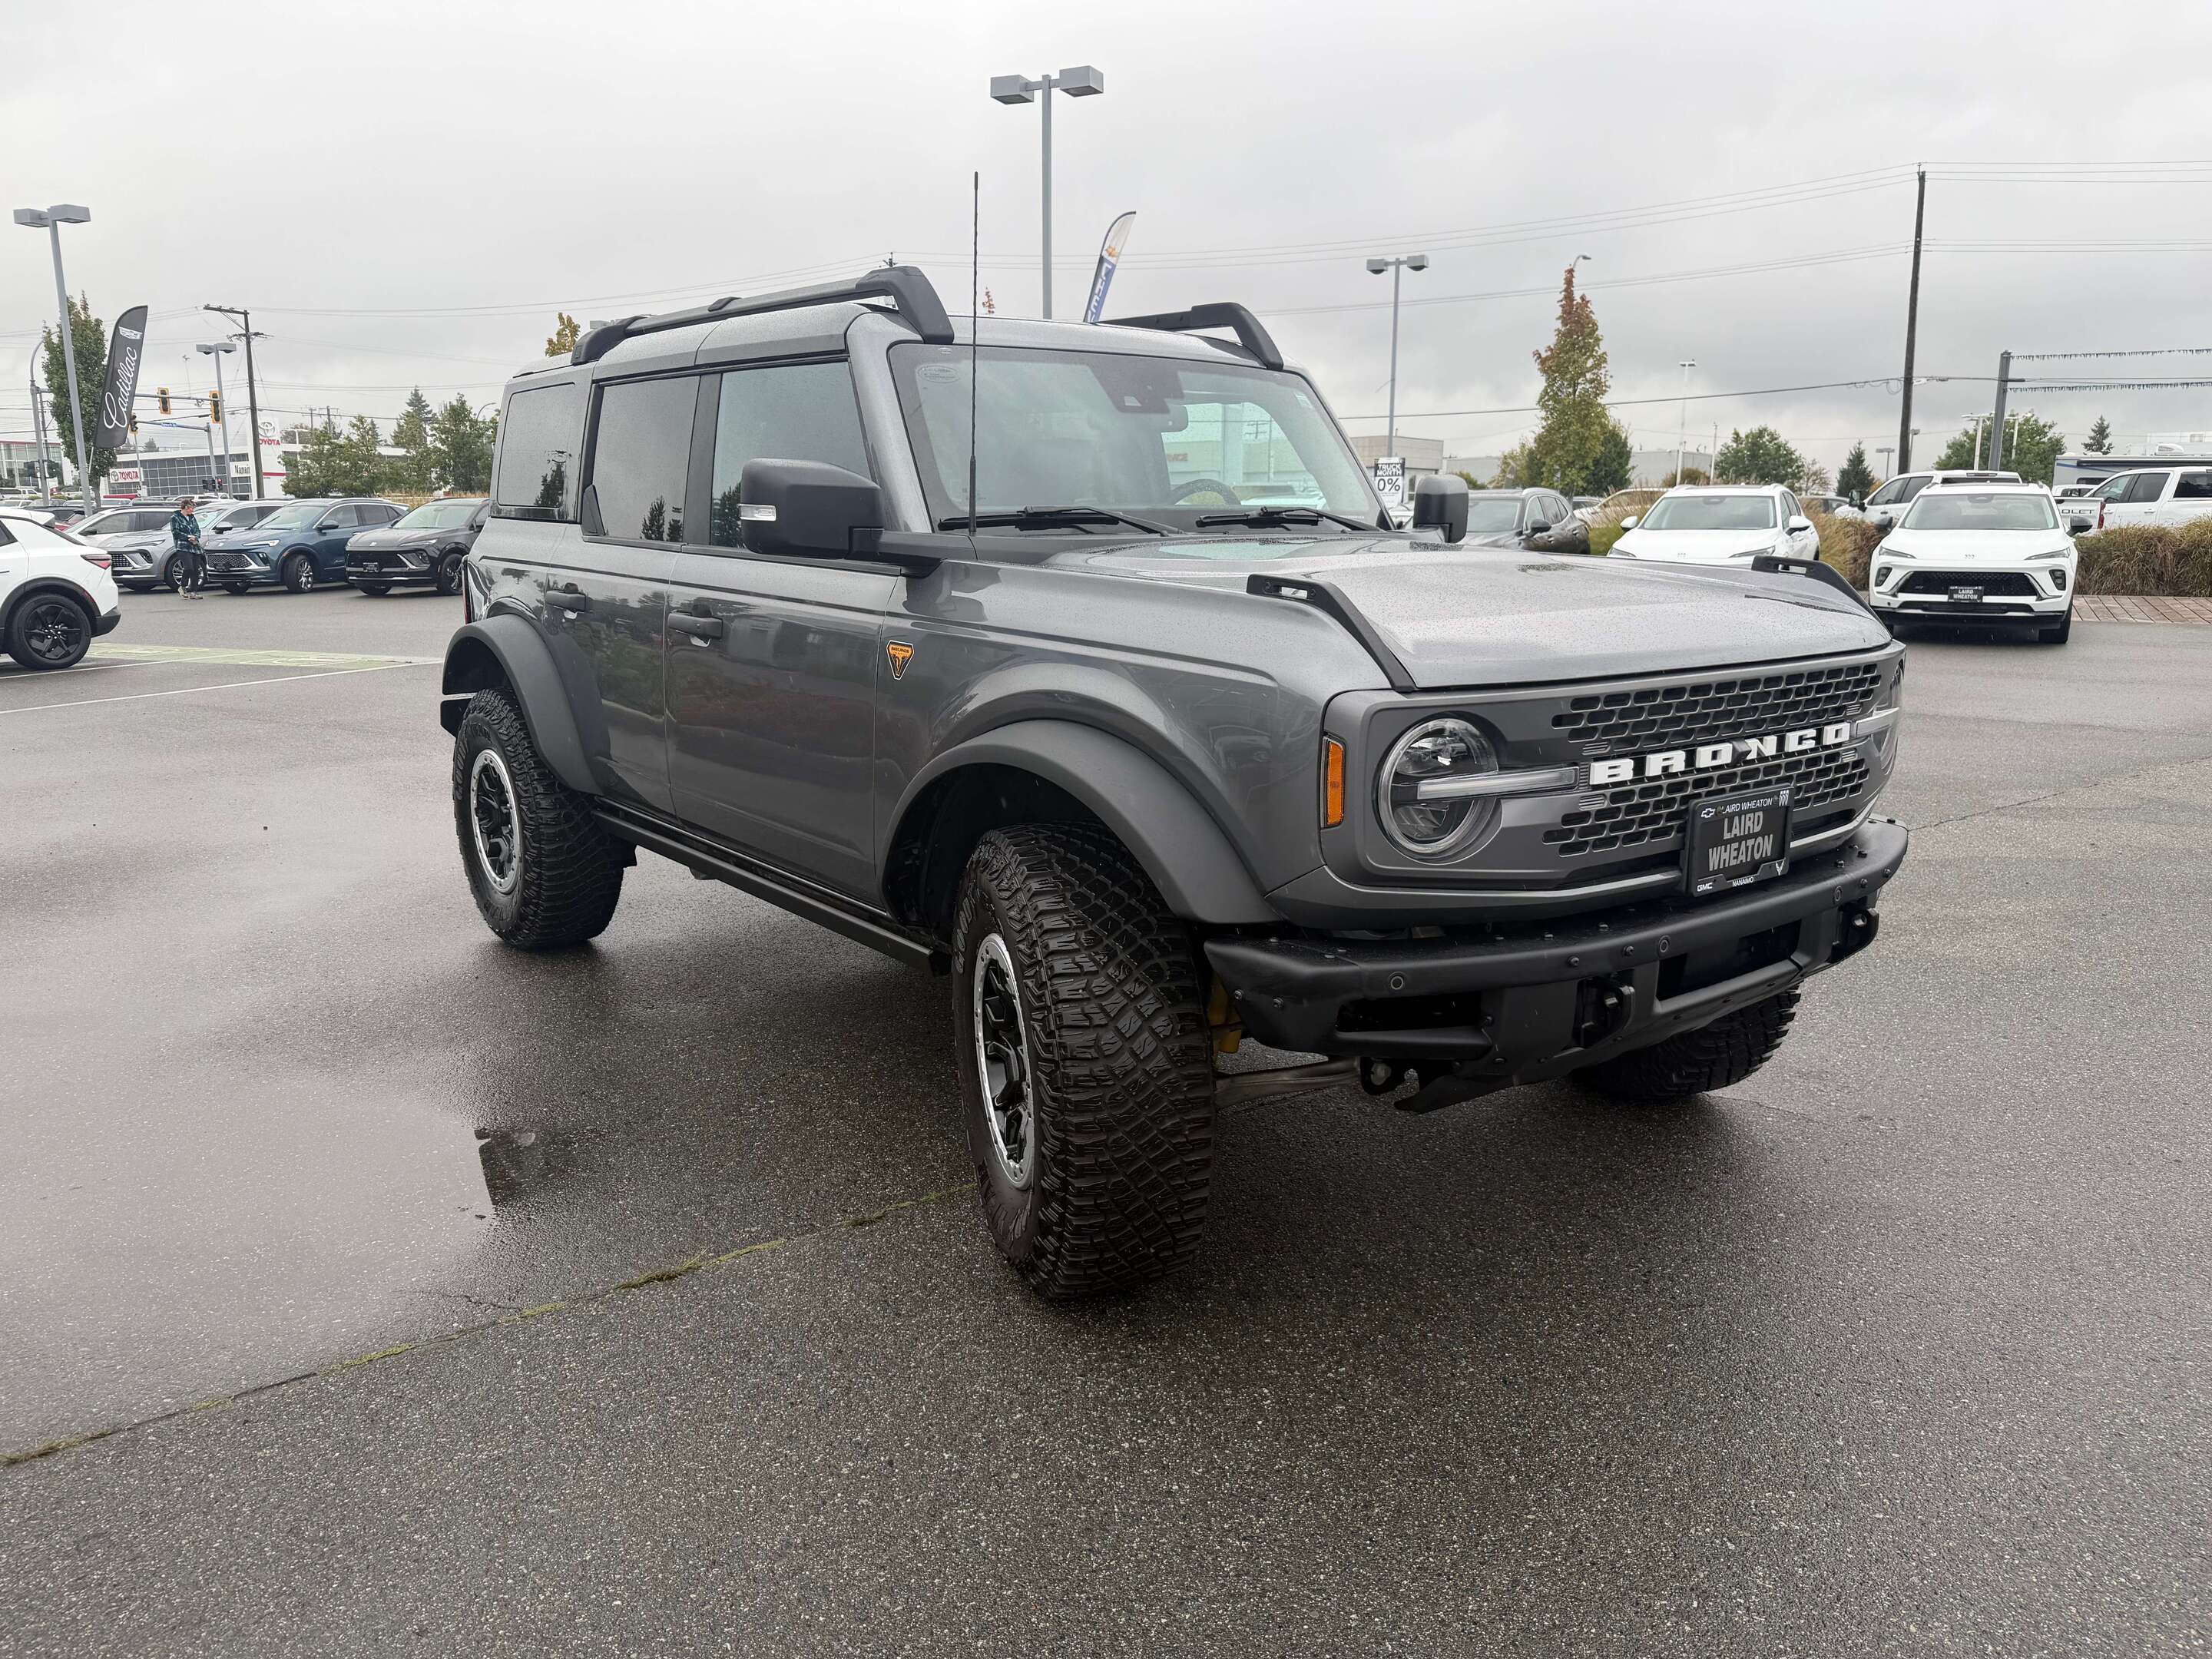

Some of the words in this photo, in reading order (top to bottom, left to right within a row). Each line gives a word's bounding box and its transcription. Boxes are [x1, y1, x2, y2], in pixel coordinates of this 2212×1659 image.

[104, 346, 137, 429] Cadillac
[118, 471, 138, 480] TOYOTA
[1377, 478, 1400, 492] 0%
[1590, 722, 1850, 785] BRONCO
[1741, 797, 1773, 810] WHEATON
[1723, 811, 1763, 839] LAIRD
[1708, 834, 1773, 871] WHEATON
[1697, 882, 1713, 892] GMC
[1732, 876, 1754, 887] NANAIMO
